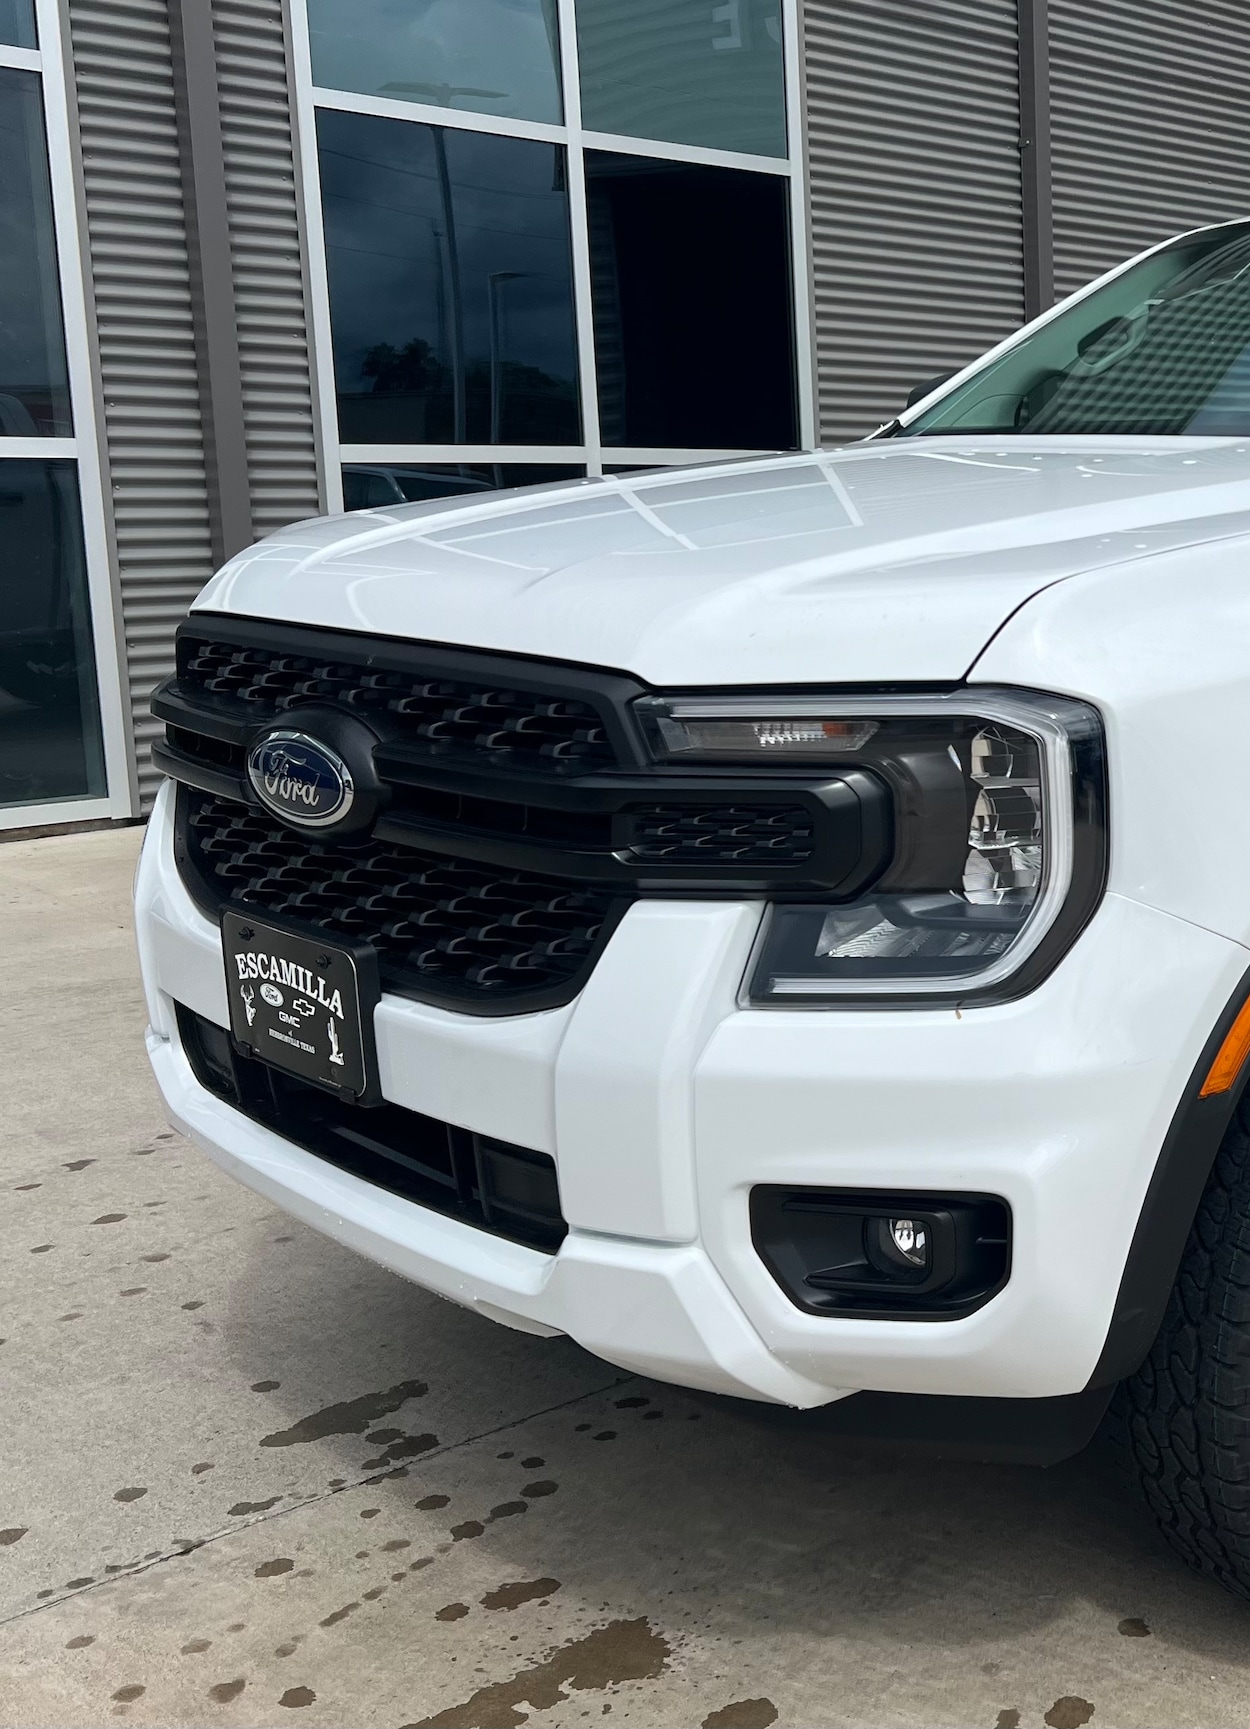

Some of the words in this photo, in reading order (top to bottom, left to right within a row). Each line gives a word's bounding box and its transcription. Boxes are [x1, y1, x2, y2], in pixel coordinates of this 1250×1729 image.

[264, 749, 320, 807] Ford
[234, 952, 345, 1020] ESCAMILLA
[278, 1010, 301, 1028] GMC
